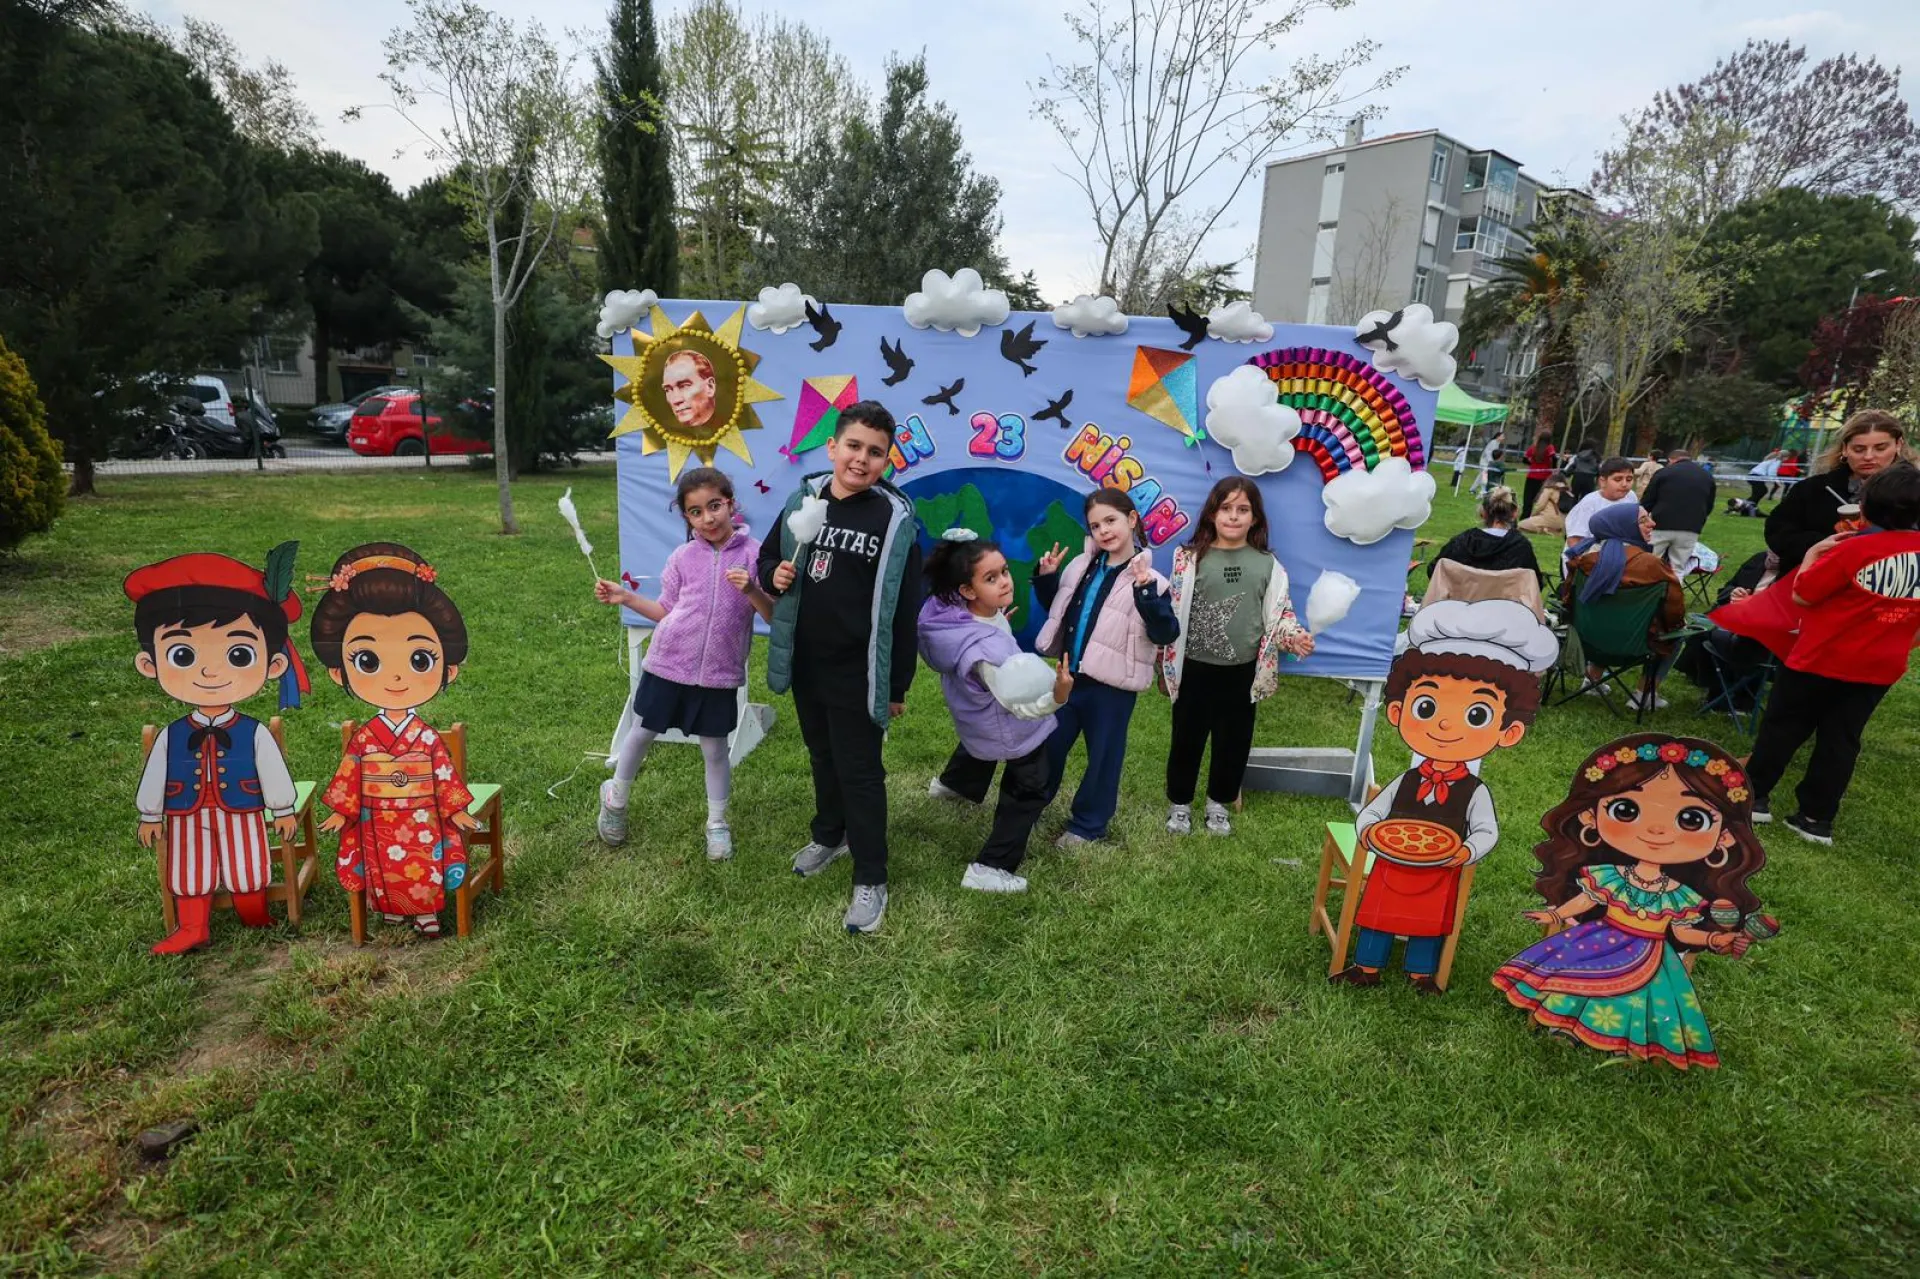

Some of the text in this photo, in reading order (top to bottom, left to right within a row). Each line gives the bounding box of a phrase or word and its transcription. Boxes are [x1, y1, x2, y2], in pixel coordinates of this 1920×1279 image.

[969, 411, 1026, 461] 23
[815, 520, 879, 562] İKTAŞ
[1855, 551, 1920, 599] BEYOND
